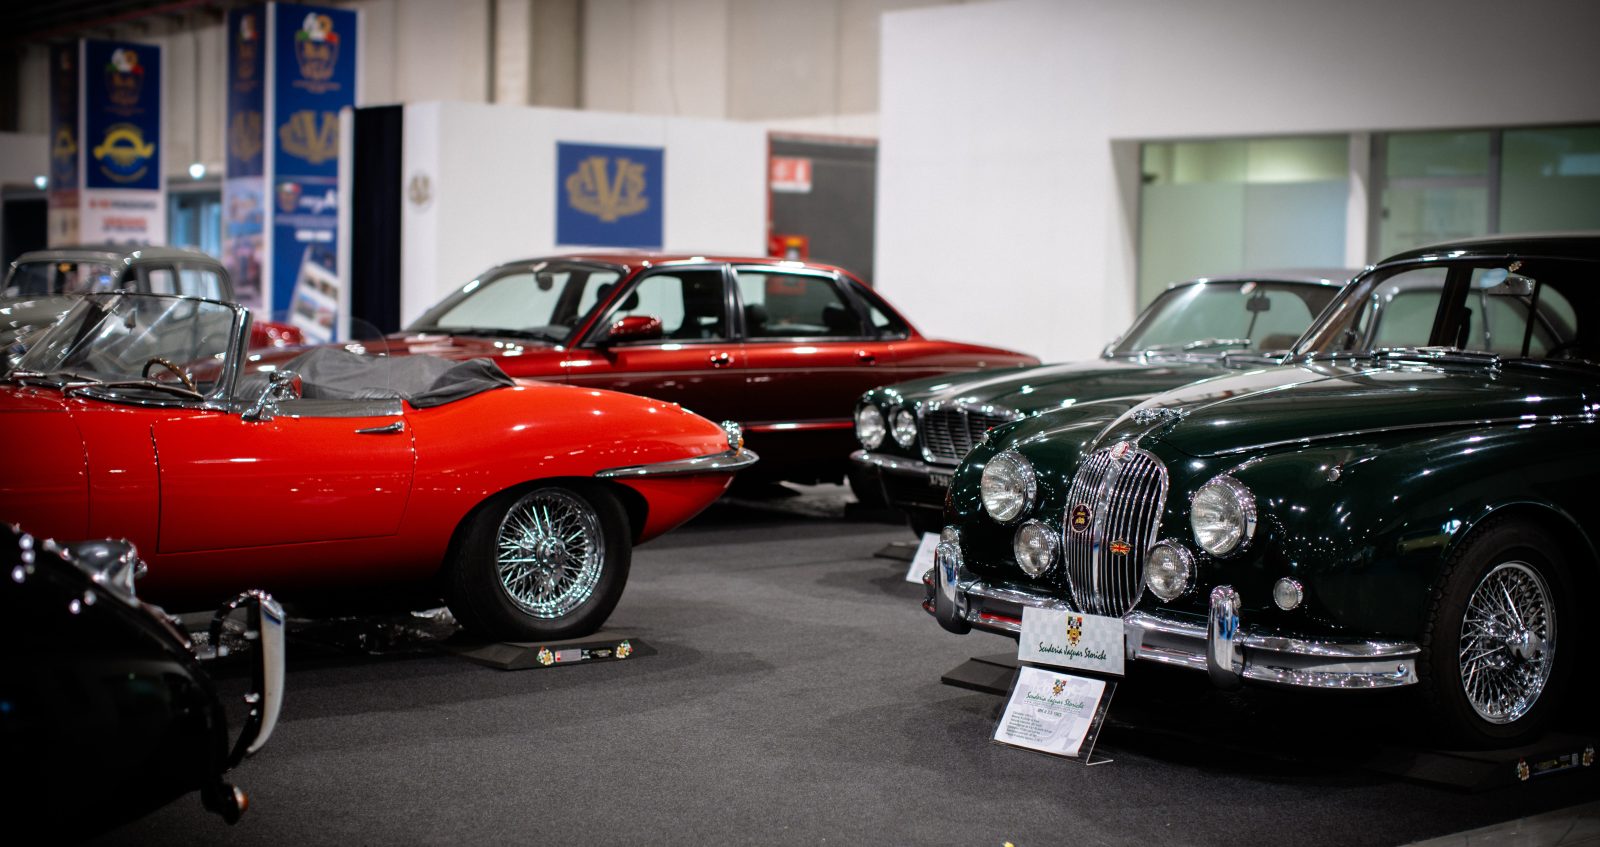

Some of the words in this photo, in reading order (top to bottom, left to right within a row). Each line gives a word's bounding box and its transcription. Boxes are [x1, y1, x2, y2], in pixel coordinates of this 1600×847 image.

[1039, 642, 1064, 655] Scuderia
[1064, 647, 1083, 660] Jaguar
[1085, 648, 1107, 660] Storiche
[1026, 692, 1046, 702] Scuderia
[1047, 696, 1063, 706] Jaguar
[1064, 698, 1085, 709] Storiche
